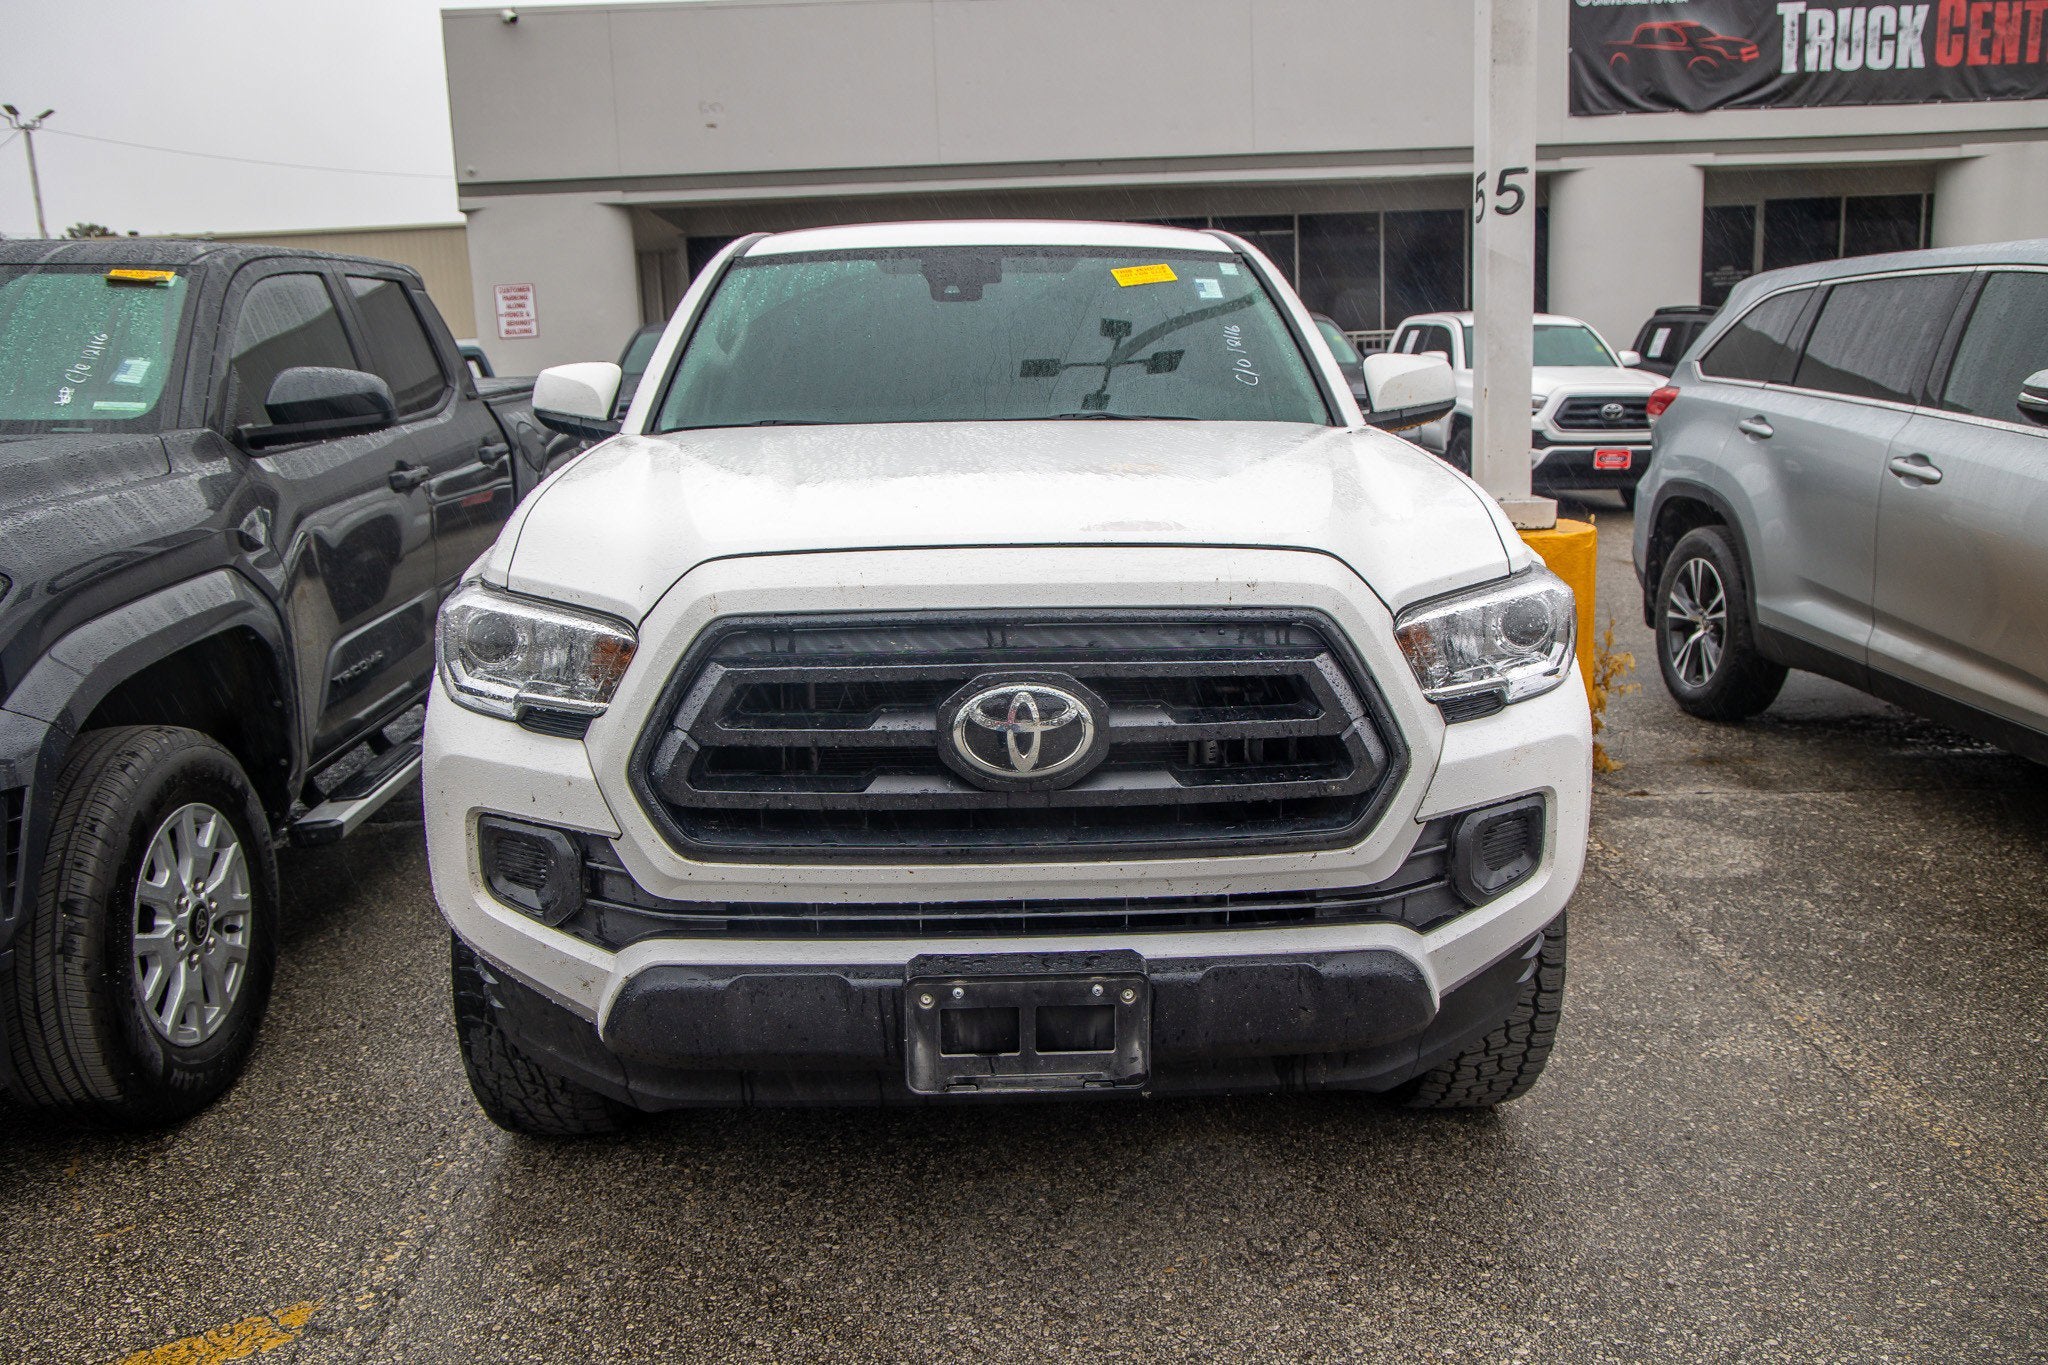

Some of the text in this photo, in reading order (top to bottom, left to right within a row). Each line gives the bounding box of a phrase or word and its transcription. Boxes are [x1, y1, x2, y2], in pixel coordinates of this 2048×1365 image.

[1776, 0, 2048, 74] TRUCK CENT
[1495, 167, 1529, 215] 5
[498, 286, 531, 294] CUSTOMER
